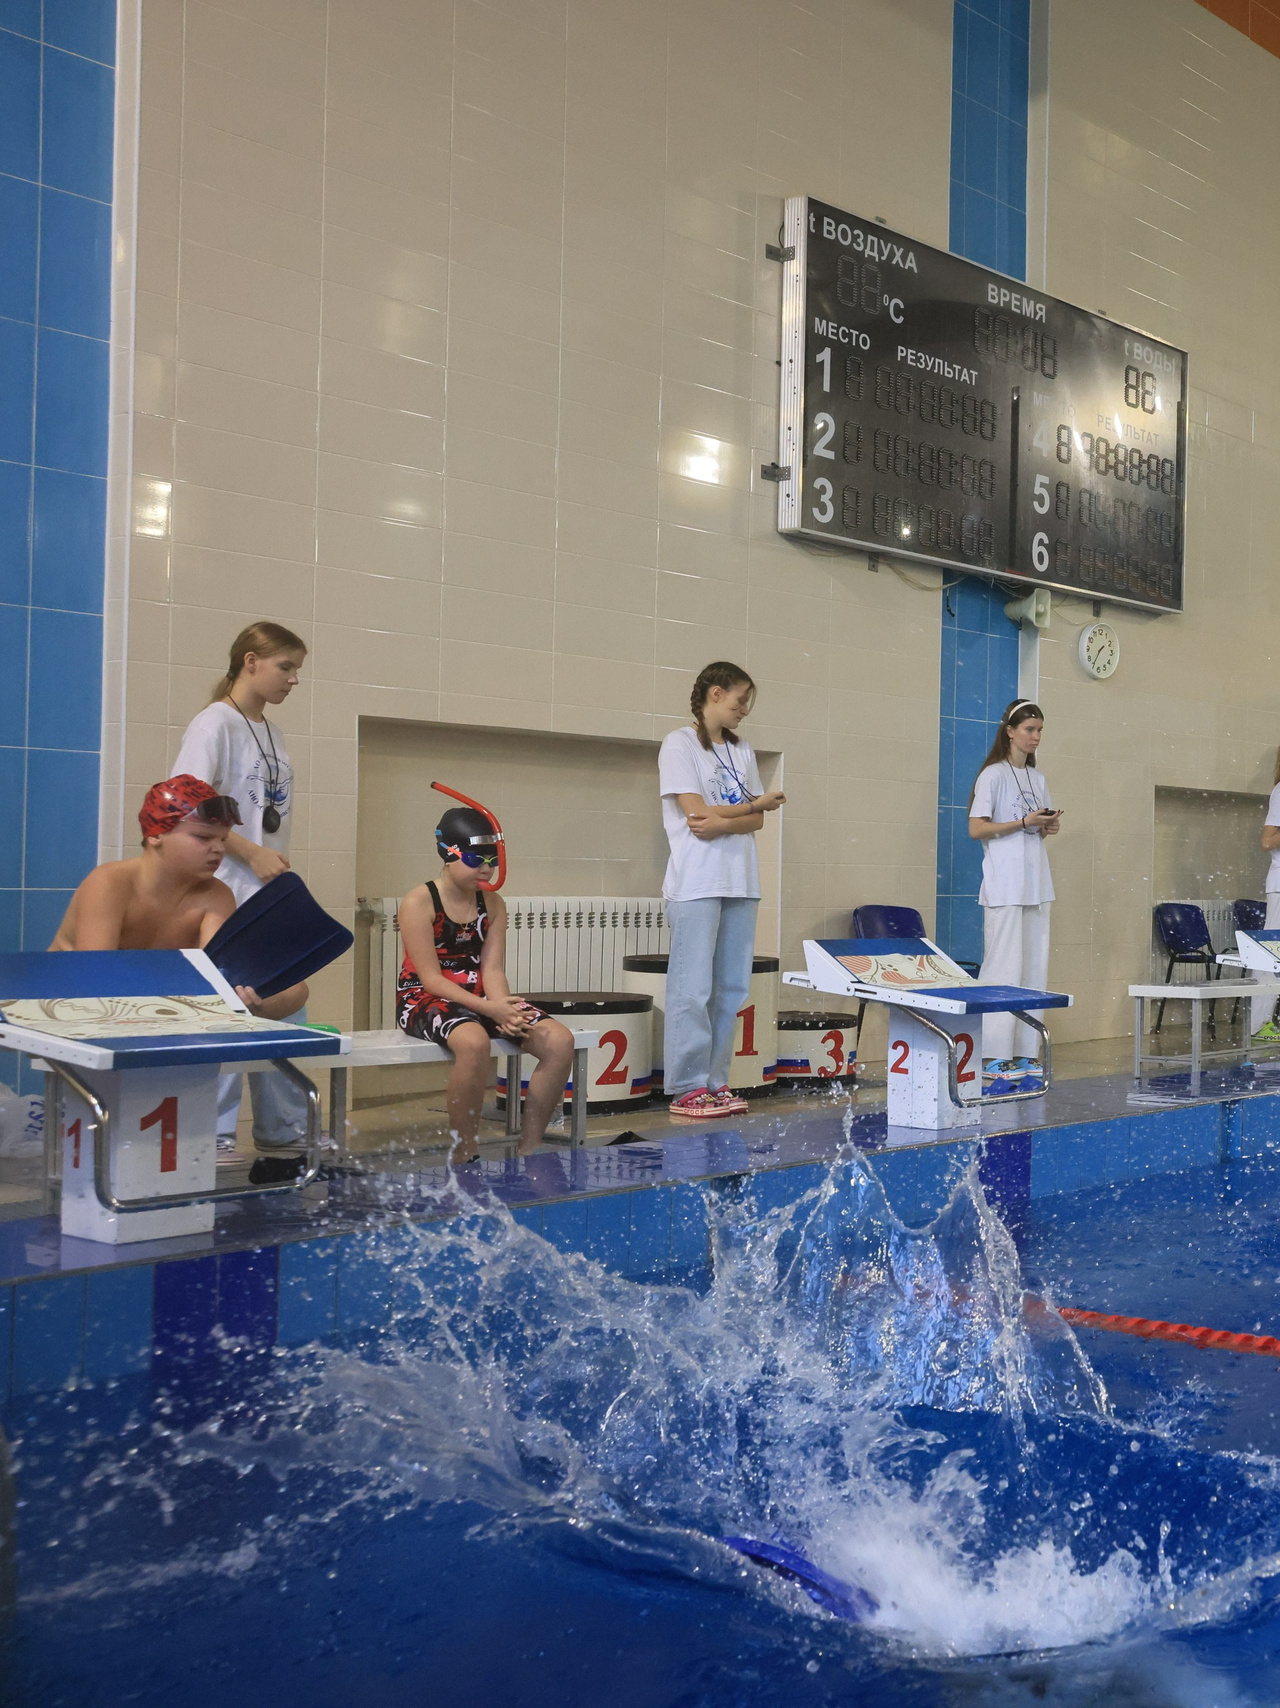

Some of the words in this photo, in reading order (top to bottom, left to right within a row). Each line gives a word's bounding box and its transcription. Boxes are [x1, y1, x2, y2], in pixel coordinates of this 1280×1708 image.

[823, 216, 918, 273] ВОЗДУХА
[988, 283, 1046, 323] ВРЕМЯ
[814, 317, 871, 350] МЕСТО
[816, 347, 831, 393] 1
[897, 346, 979, 386] РЕЗУЛЬТАТ
[1133, 342, 1176, 376] ВОДЫ
[813, 412, 836, 460] 2
[1033, 419, 1050, 457] 4
[812, 477, 834, 523] 3
[1033, 473, 1050, 515] 5
[1032, 531, 1050, 572] 6
[735, 1004, 759, 1057] 1
[595, 1029, 629, 1085] 2
[817, 1030, 844, 1078] 3
[890, 1039, 910, 1075] 2
[954, 1032, 976, 1083] 2
[67, 1118, 82, 1169] 1
[140, 1096, 179, 1172] 1
